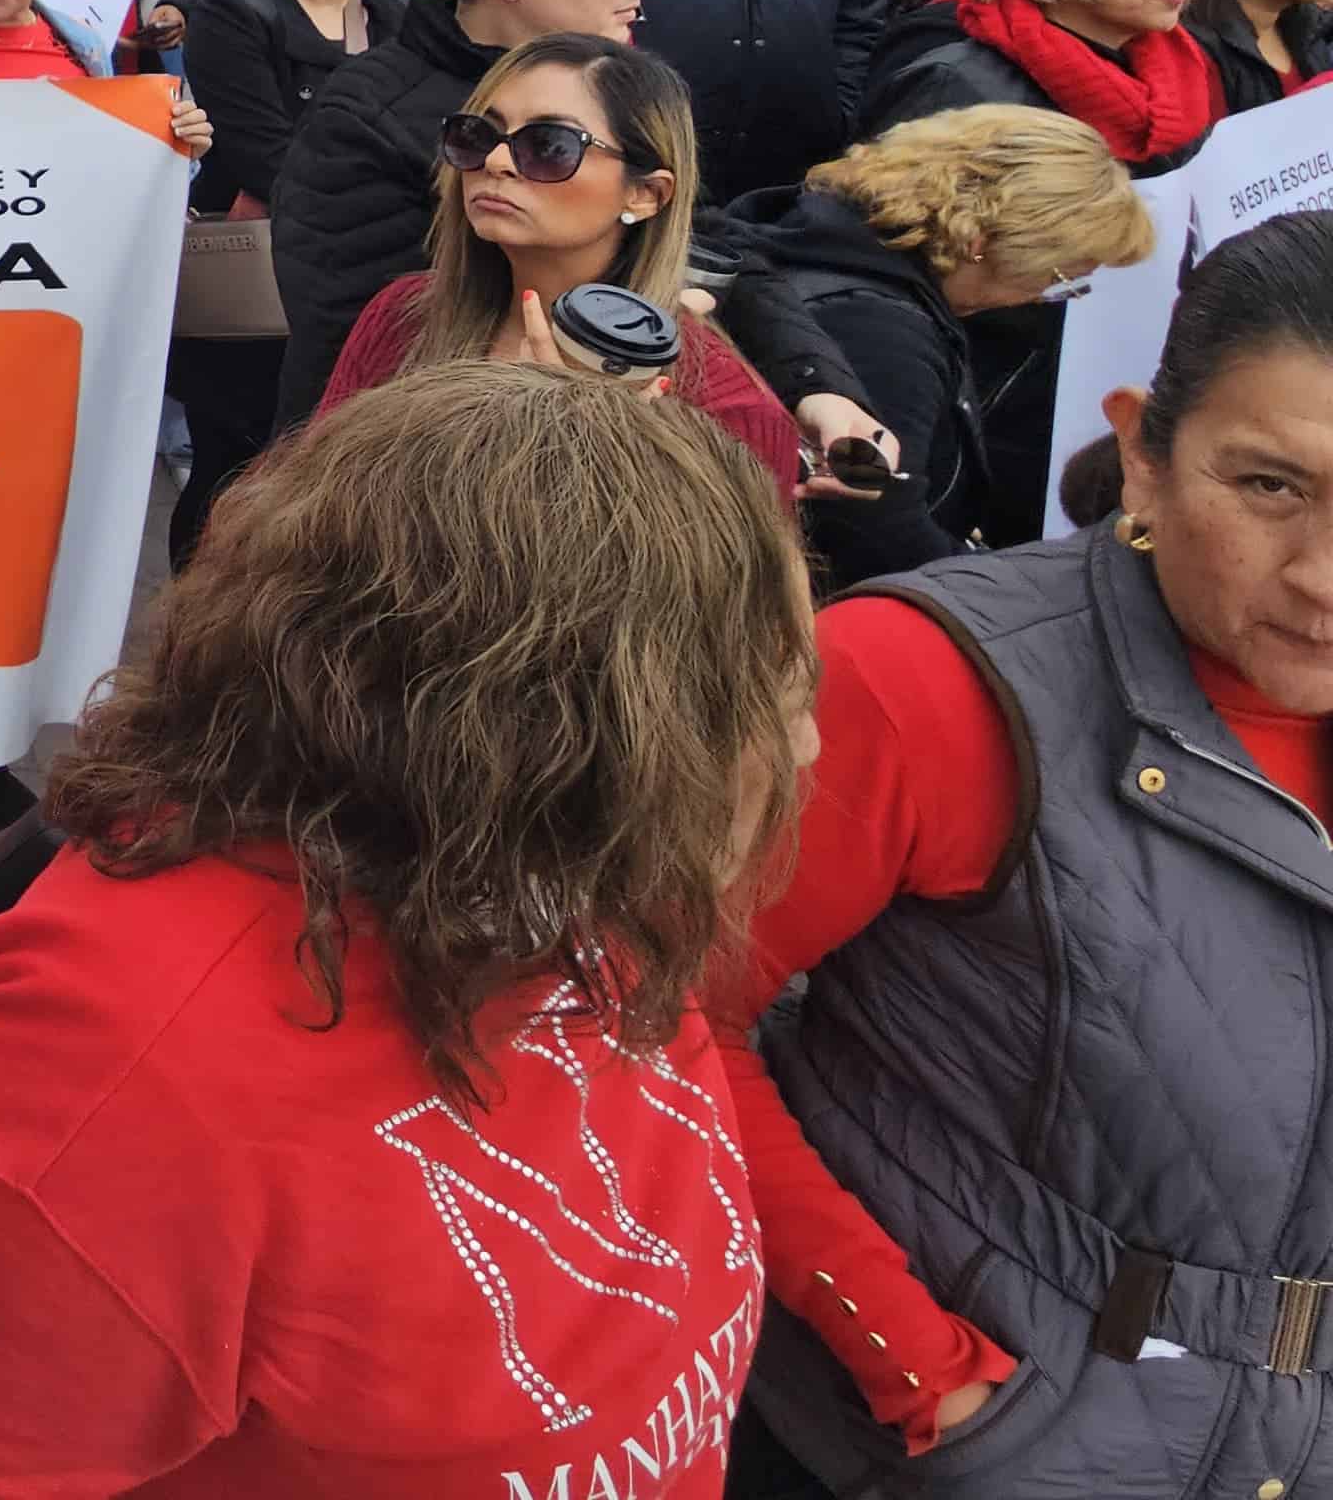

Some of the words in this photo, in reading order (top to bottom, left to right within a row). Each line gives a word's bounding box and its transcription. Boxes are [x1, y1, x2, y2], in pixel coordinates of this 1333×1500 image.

[16, 168, 49, 189] Y
[1230, 190, 1247, 218] EN
[1245, 175, 1280, 210] ESTA
